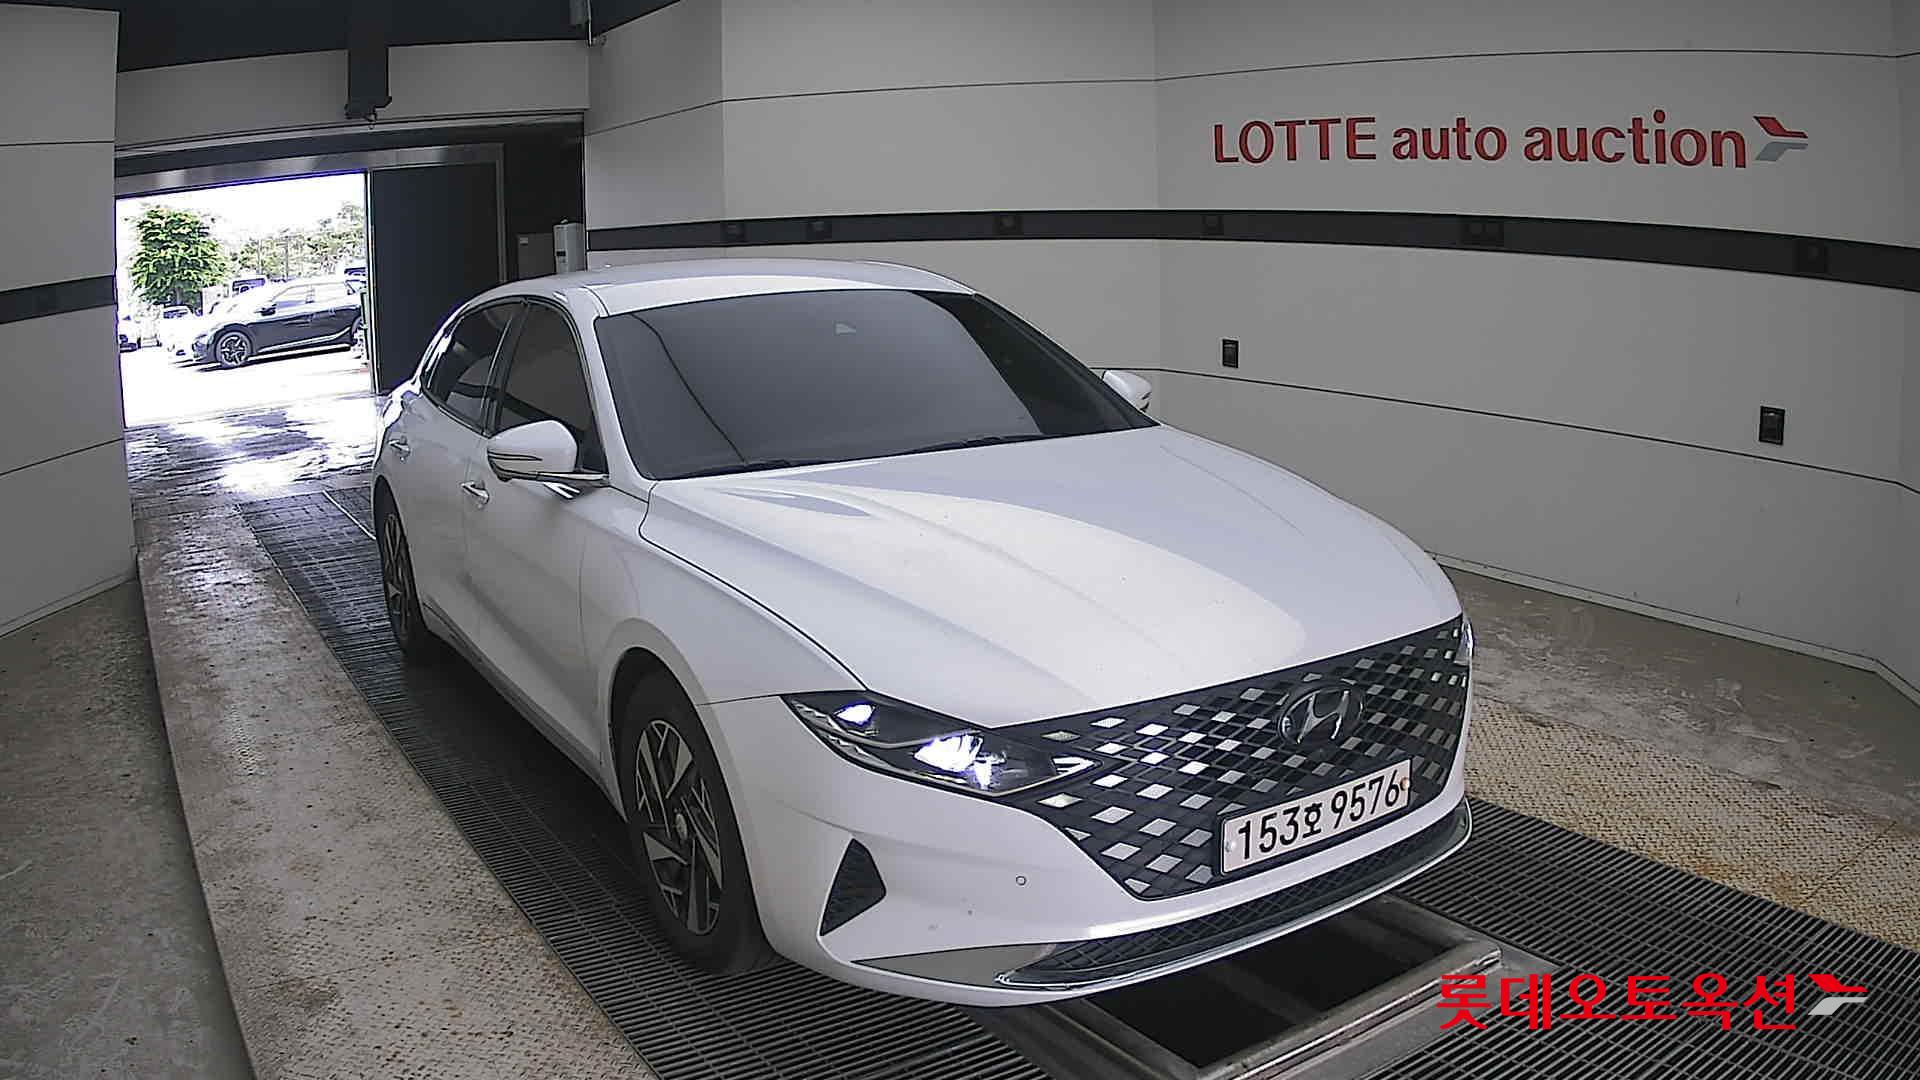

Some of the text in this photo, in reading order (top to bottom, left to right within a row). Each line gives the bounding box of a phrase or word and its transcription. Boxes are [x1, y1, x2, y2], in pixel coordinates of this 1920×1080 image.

[1213, 109, 1747, 169] LOTTE auto auction
[1238, 769, 1400, 860] 153호 9576
